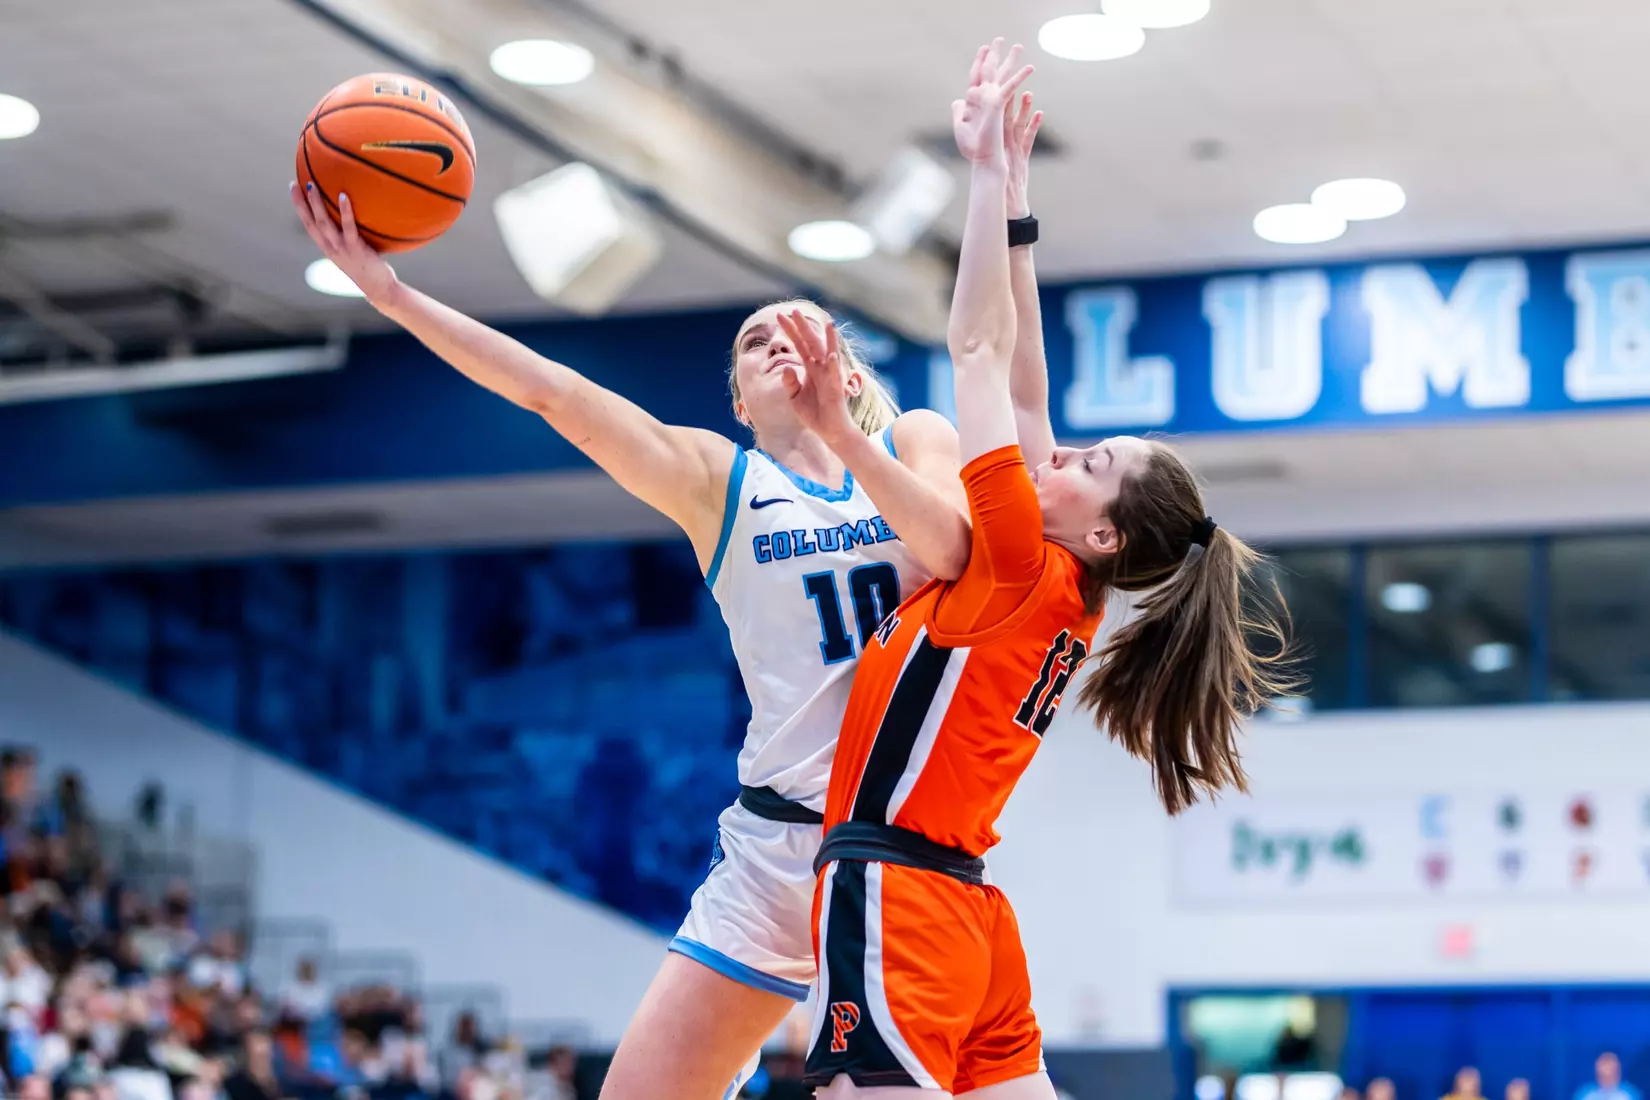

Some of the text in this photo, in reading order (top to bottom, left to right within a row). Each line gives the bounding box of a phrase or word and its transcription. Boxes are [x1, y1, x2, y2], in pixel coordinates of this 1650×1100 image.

[853, 254, 1650, 432] LUMB
[752, 515, 899, 564] COLUMB
[802, 561, 901, 665] 10
[1012, 627, 1088, 741] 12
[830, 1001, 861, 1053] P
